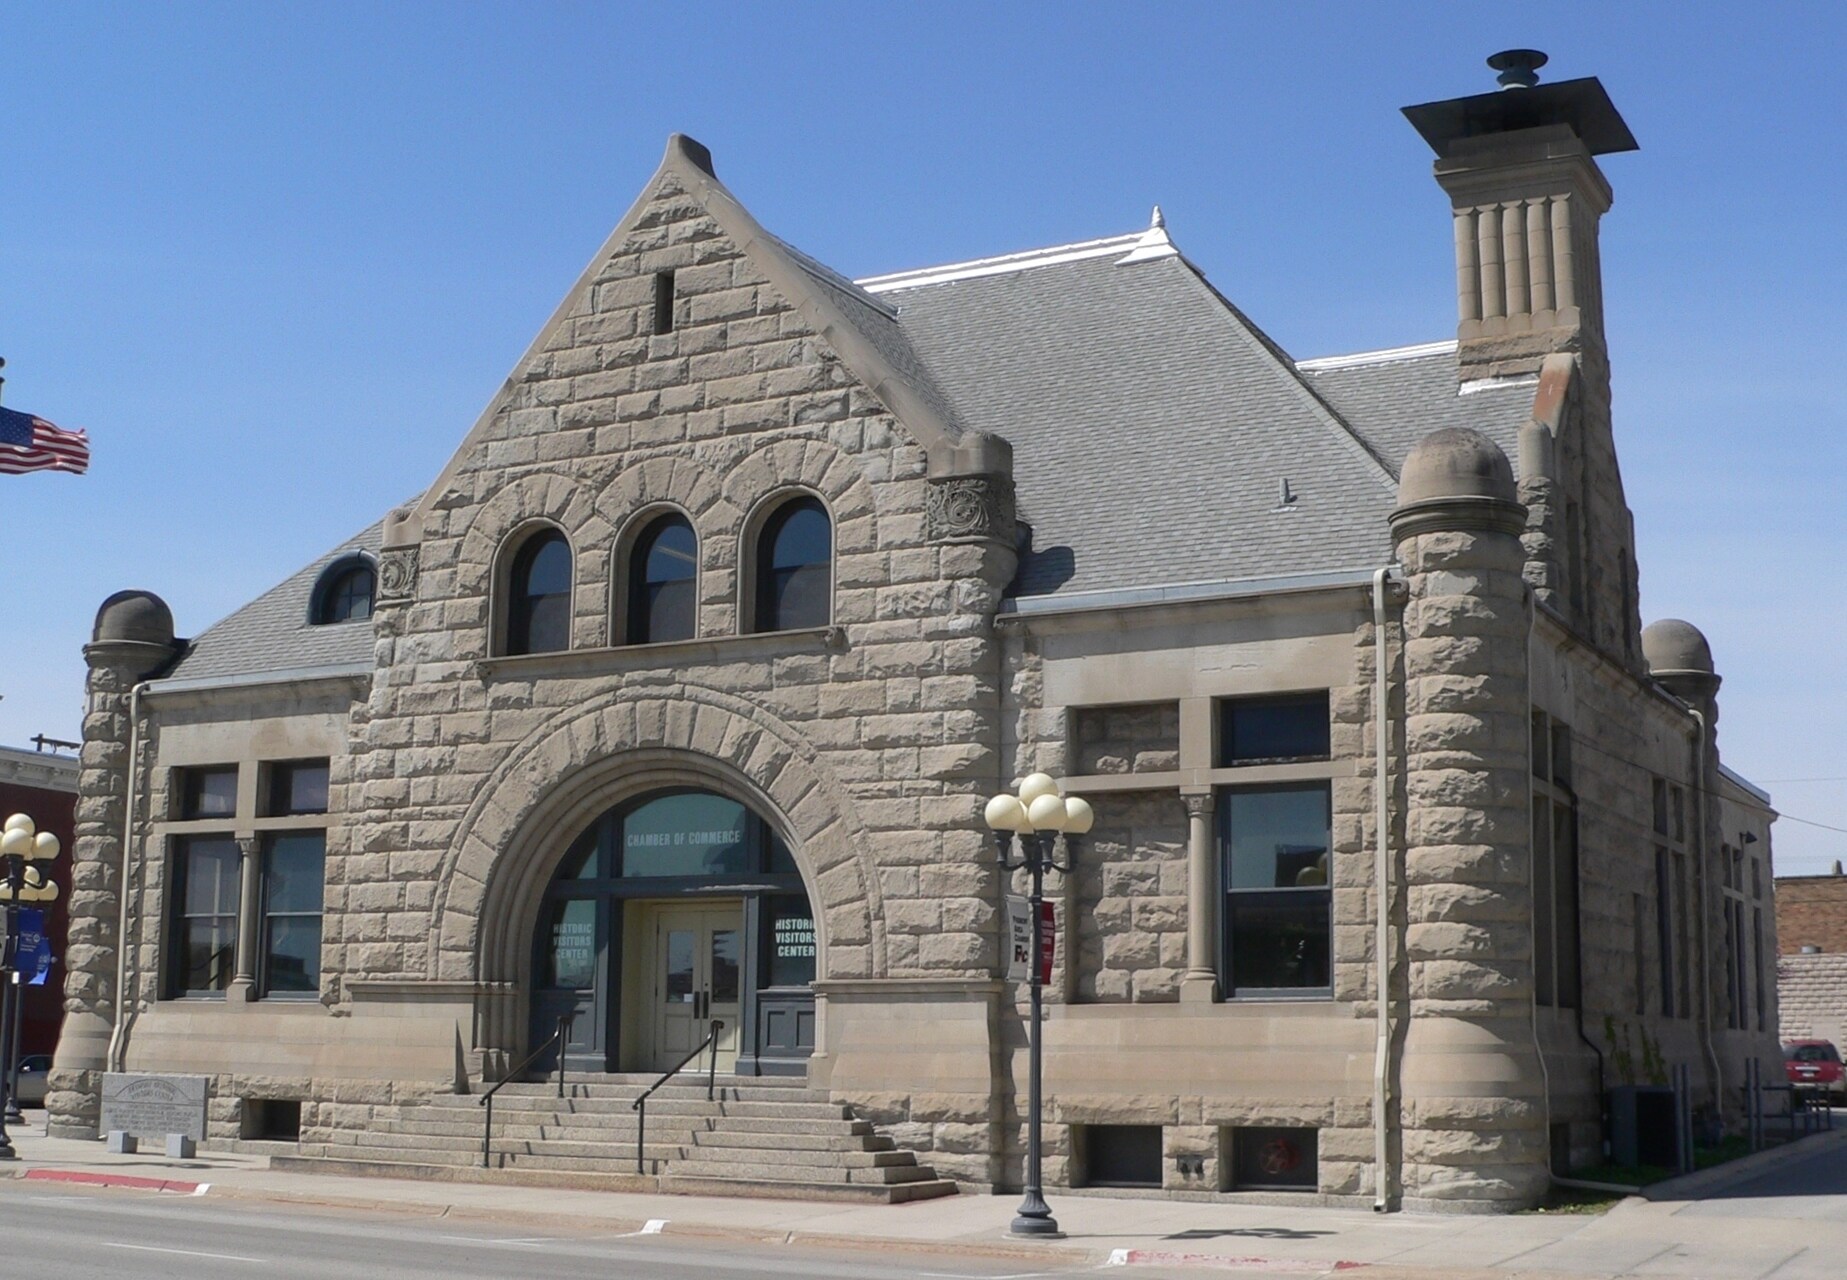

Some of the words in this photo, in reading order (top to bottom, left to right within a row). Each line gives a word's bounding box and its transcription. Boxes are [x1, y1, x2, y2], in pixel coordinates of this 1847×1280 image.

[627, 833, 670, 847] CHAMBER
[674, 832, 685, 845] OF
[688, 830, 740, 845] COMMERCE
[553, 923, 592, 934] HISTORIC
[553, 935, 592, 947] VISITORS
[775, 932, 818, 944] VISITORS
[556, 948, 588, 959] CENTER
[778, 945, 815, 957] CENTER
